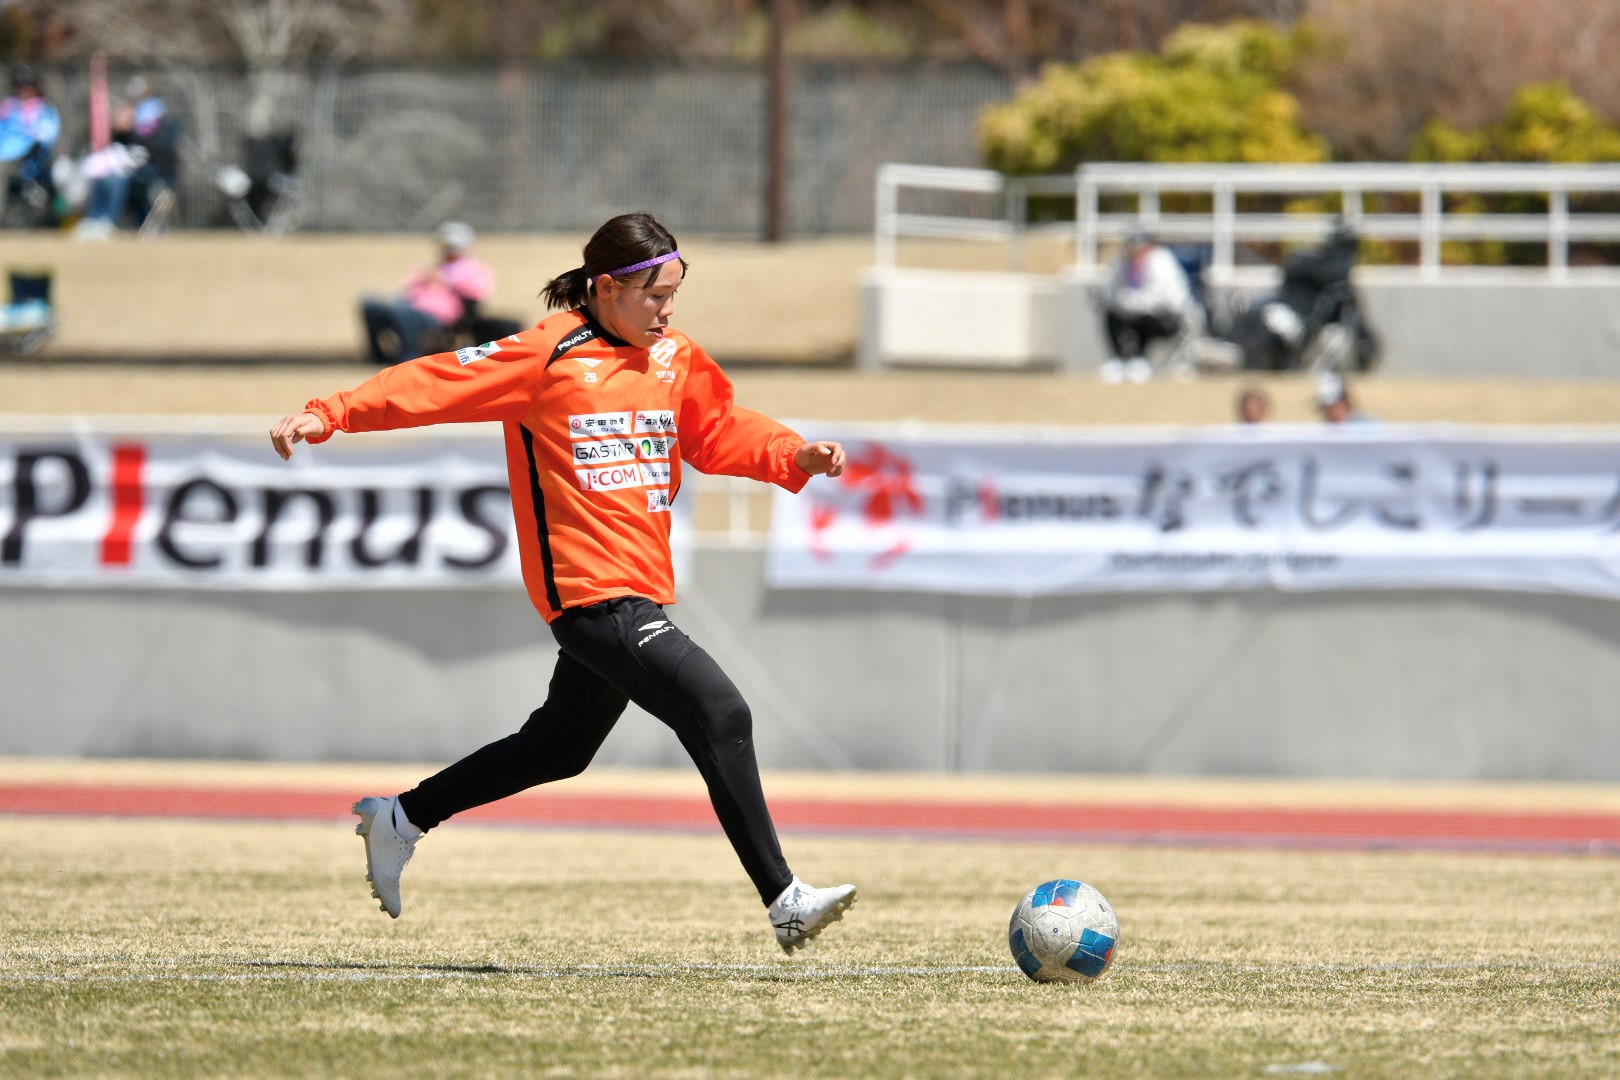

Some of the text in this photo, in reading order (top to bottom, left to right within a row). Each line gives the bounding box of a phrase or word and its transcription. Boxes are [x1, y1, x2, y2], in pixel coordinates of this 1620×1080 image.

[557, 329, 593, 351] PENALTY
[576, 442, 634, 460] GASTAR
[587, 468, 637, 490] J:COM
[2, 444, 510, 570] Plenus
[638, 626, 675, 648] PENALTY
